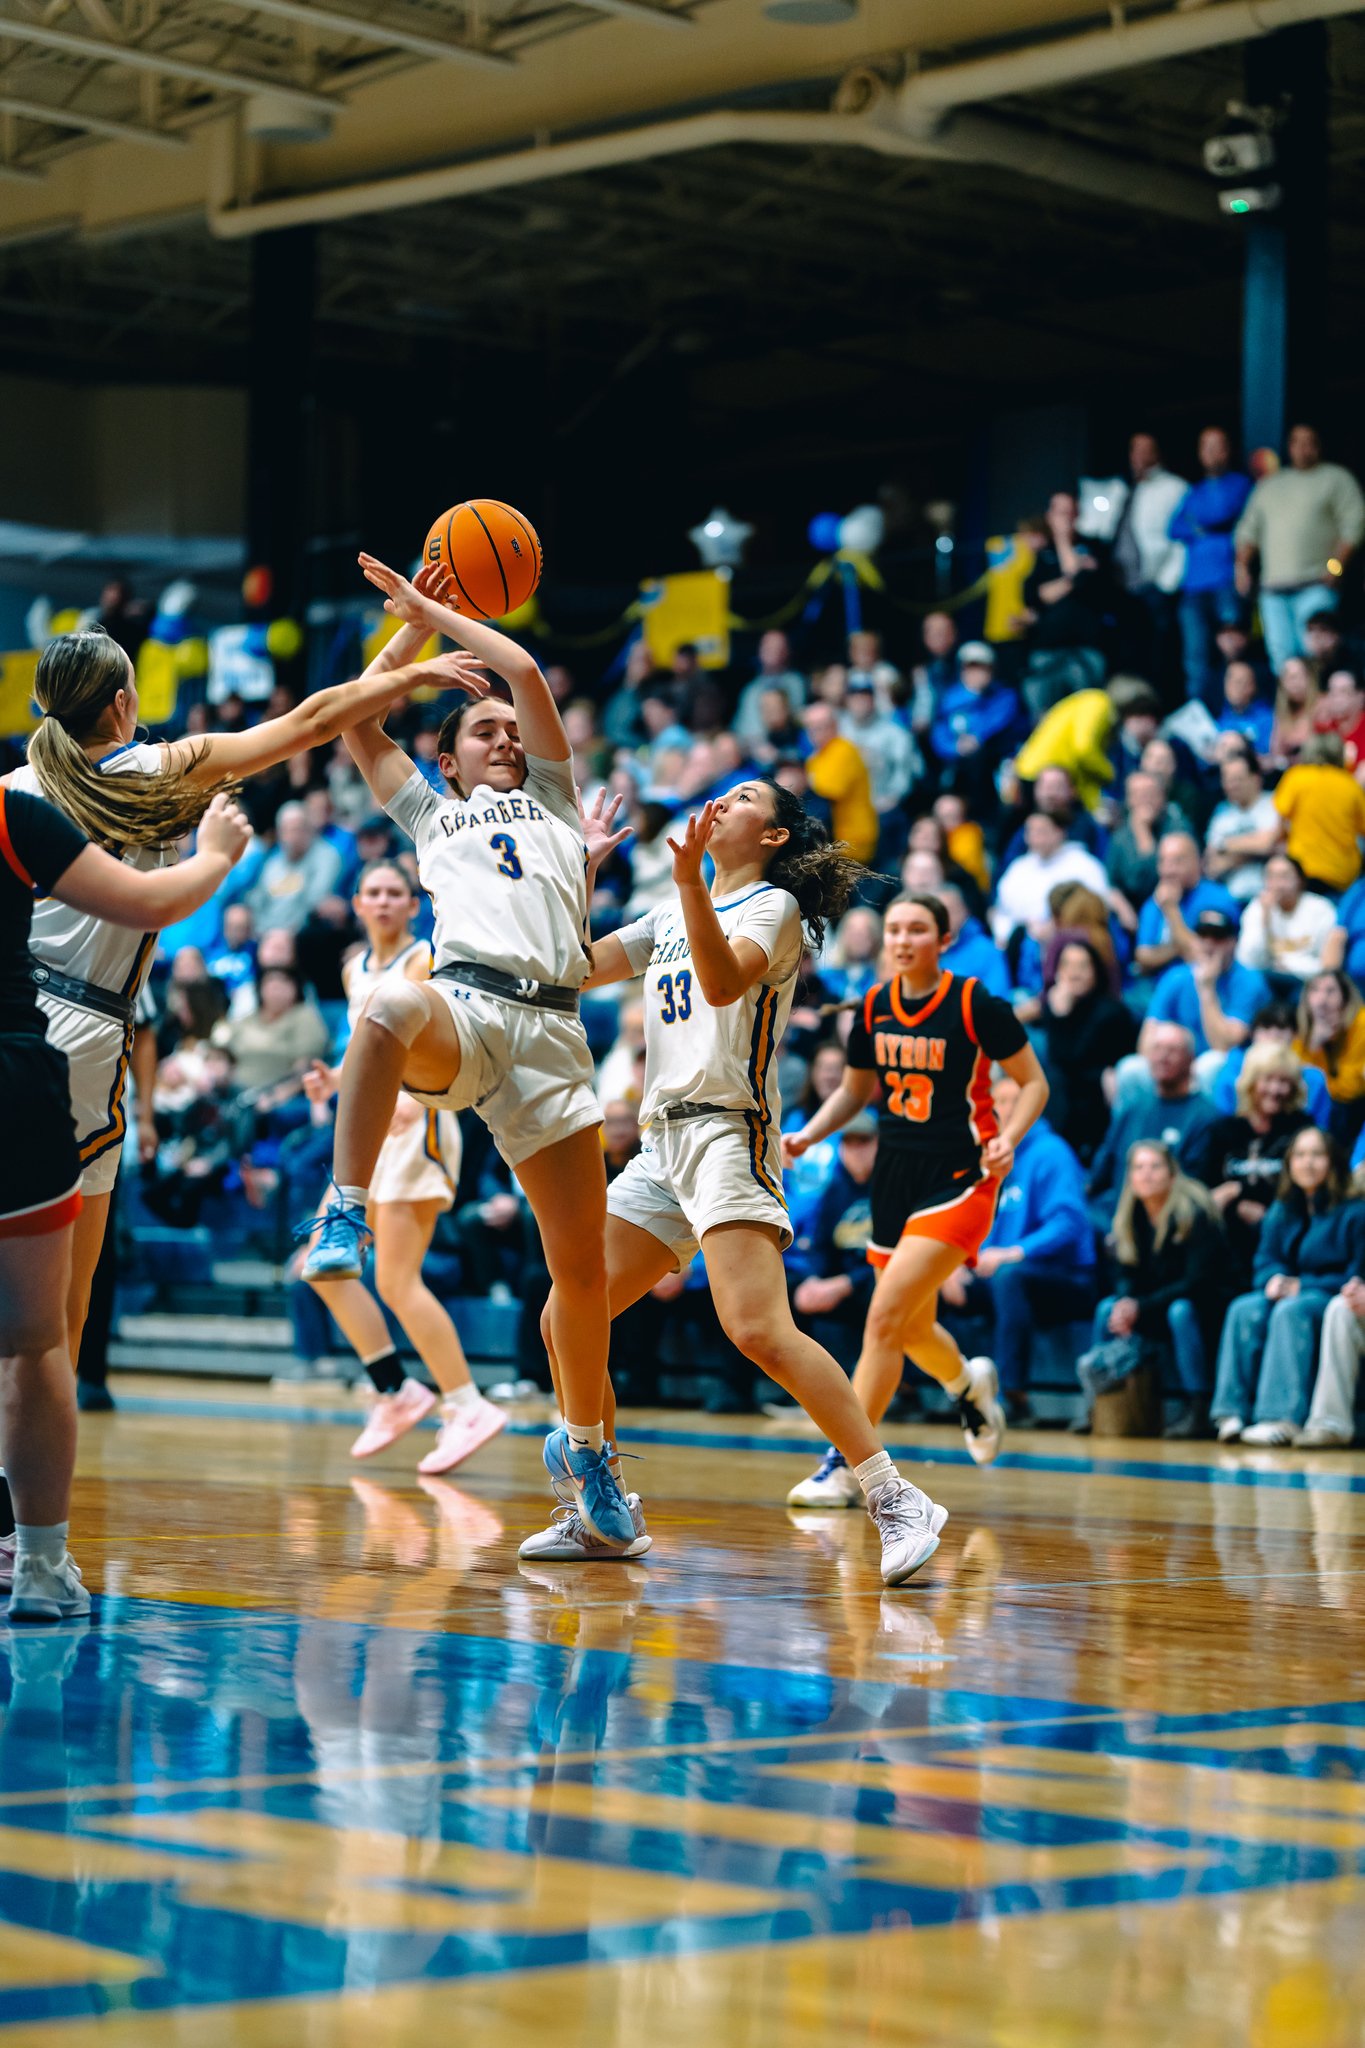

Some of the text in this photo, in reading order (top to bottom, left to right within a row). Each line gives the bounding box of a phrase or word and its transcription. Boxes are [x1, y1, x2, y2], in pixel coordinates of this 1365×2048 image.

[440, 798, 553, 838] CHARGER
[489, 832, 524, 880] 3
[648, 937, 691, 967] CHARG
[657, 968, 692, 1025] 33
[884, 1070, 934, 1123] 23
